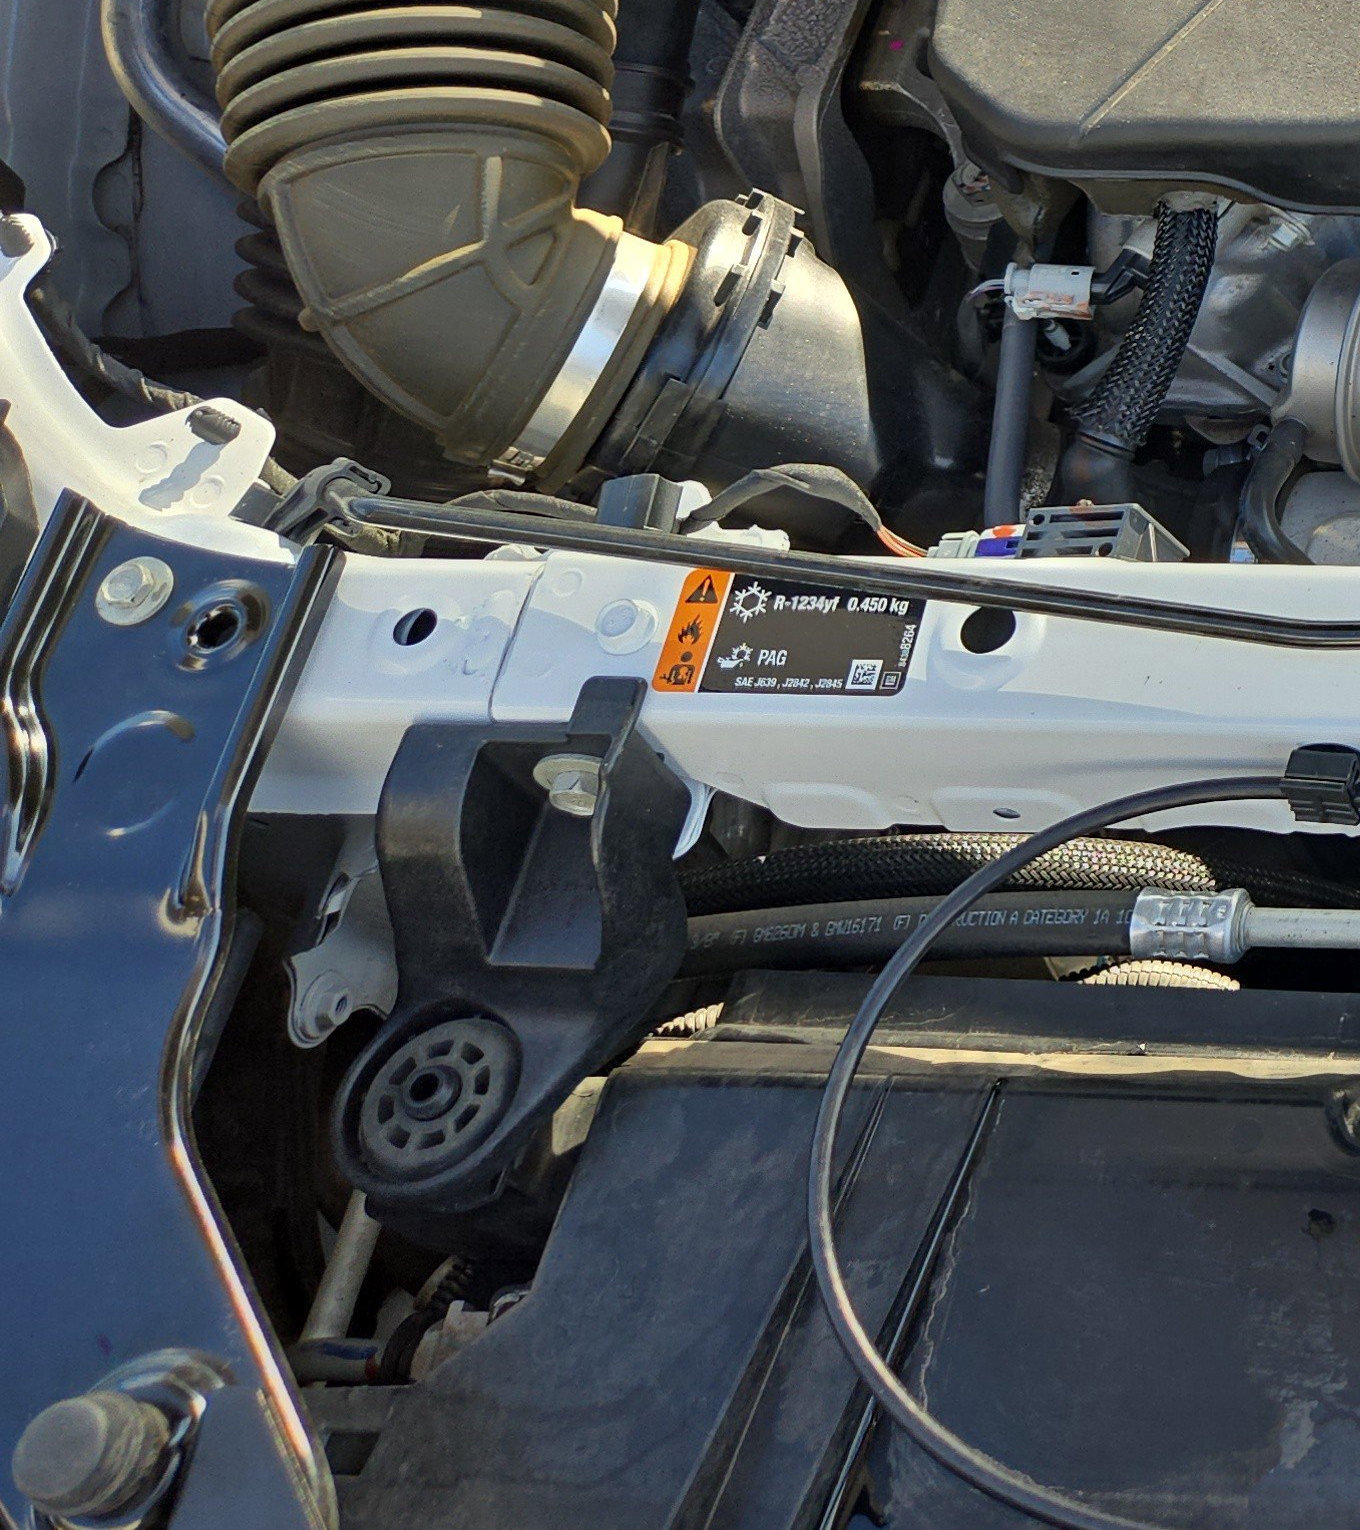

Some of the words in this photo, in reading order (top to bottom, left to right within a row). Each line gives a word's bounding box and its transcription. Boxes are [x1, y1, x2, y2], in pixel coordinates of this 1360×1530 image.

[773, 595, 840, 614] R-1234yf
[847, 597, 888, 613] 0.450
[889, 599, 910, 616] kg
[756, 649, 788, 668] PAG
[734, 676, 754, 687] SAE
[1024, 908, 1088, 925] CATEGORY
